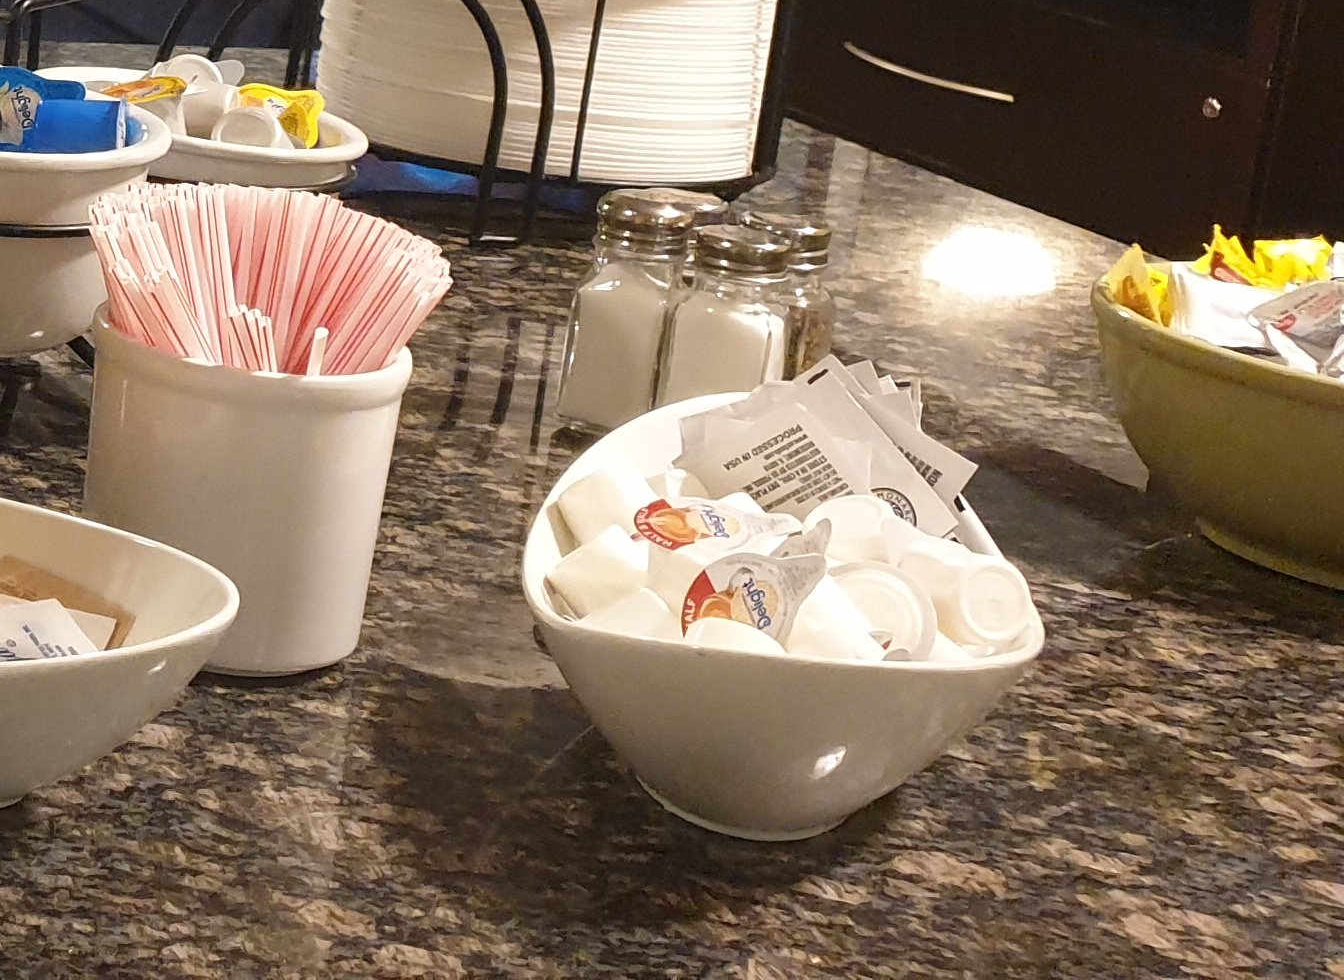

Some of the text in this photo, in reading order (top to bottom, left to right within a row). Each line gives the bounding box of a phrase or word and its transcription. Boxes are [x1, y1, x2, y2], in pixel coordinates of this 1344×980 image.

[751, 424, 804, 457] PROCESSED
[723, 456, 742, 472] USA
[741, 452, 751, 463] IN
[741, 576, 772, 631] Delight
